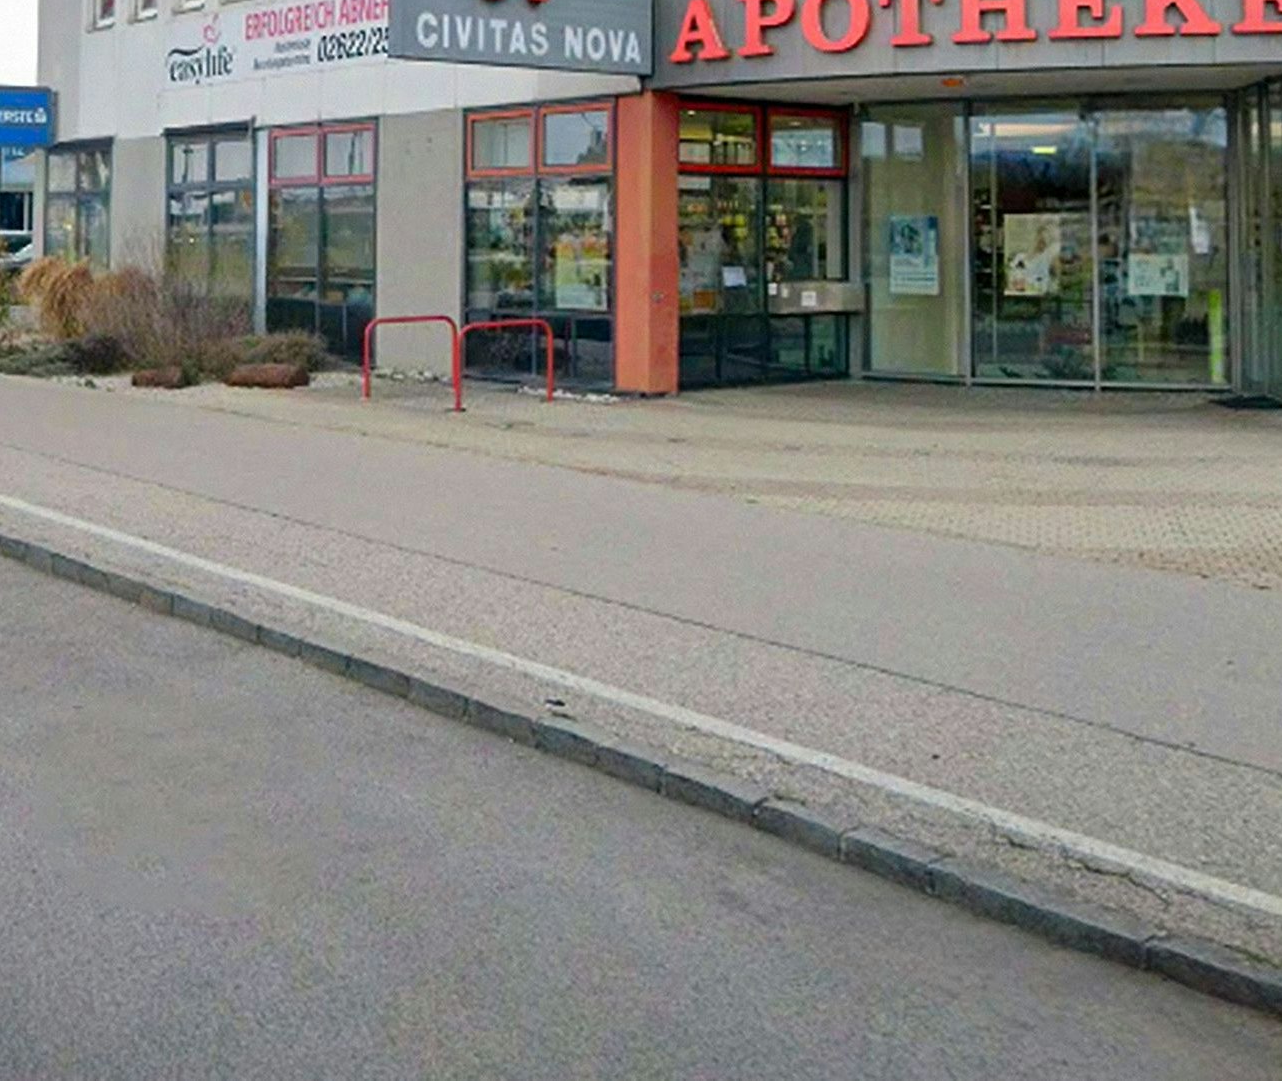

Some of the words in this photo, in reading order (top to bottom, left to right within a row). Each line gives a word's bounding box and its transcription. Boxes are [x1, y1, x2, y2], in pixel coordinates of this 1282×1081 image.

[245, 0, 335, 41] ERFOLGREICH
[416, 11, 550, 56] CIVITAS
[564, 25, 642, 64] NOVA
[168, 45, 234, 85] easylife
